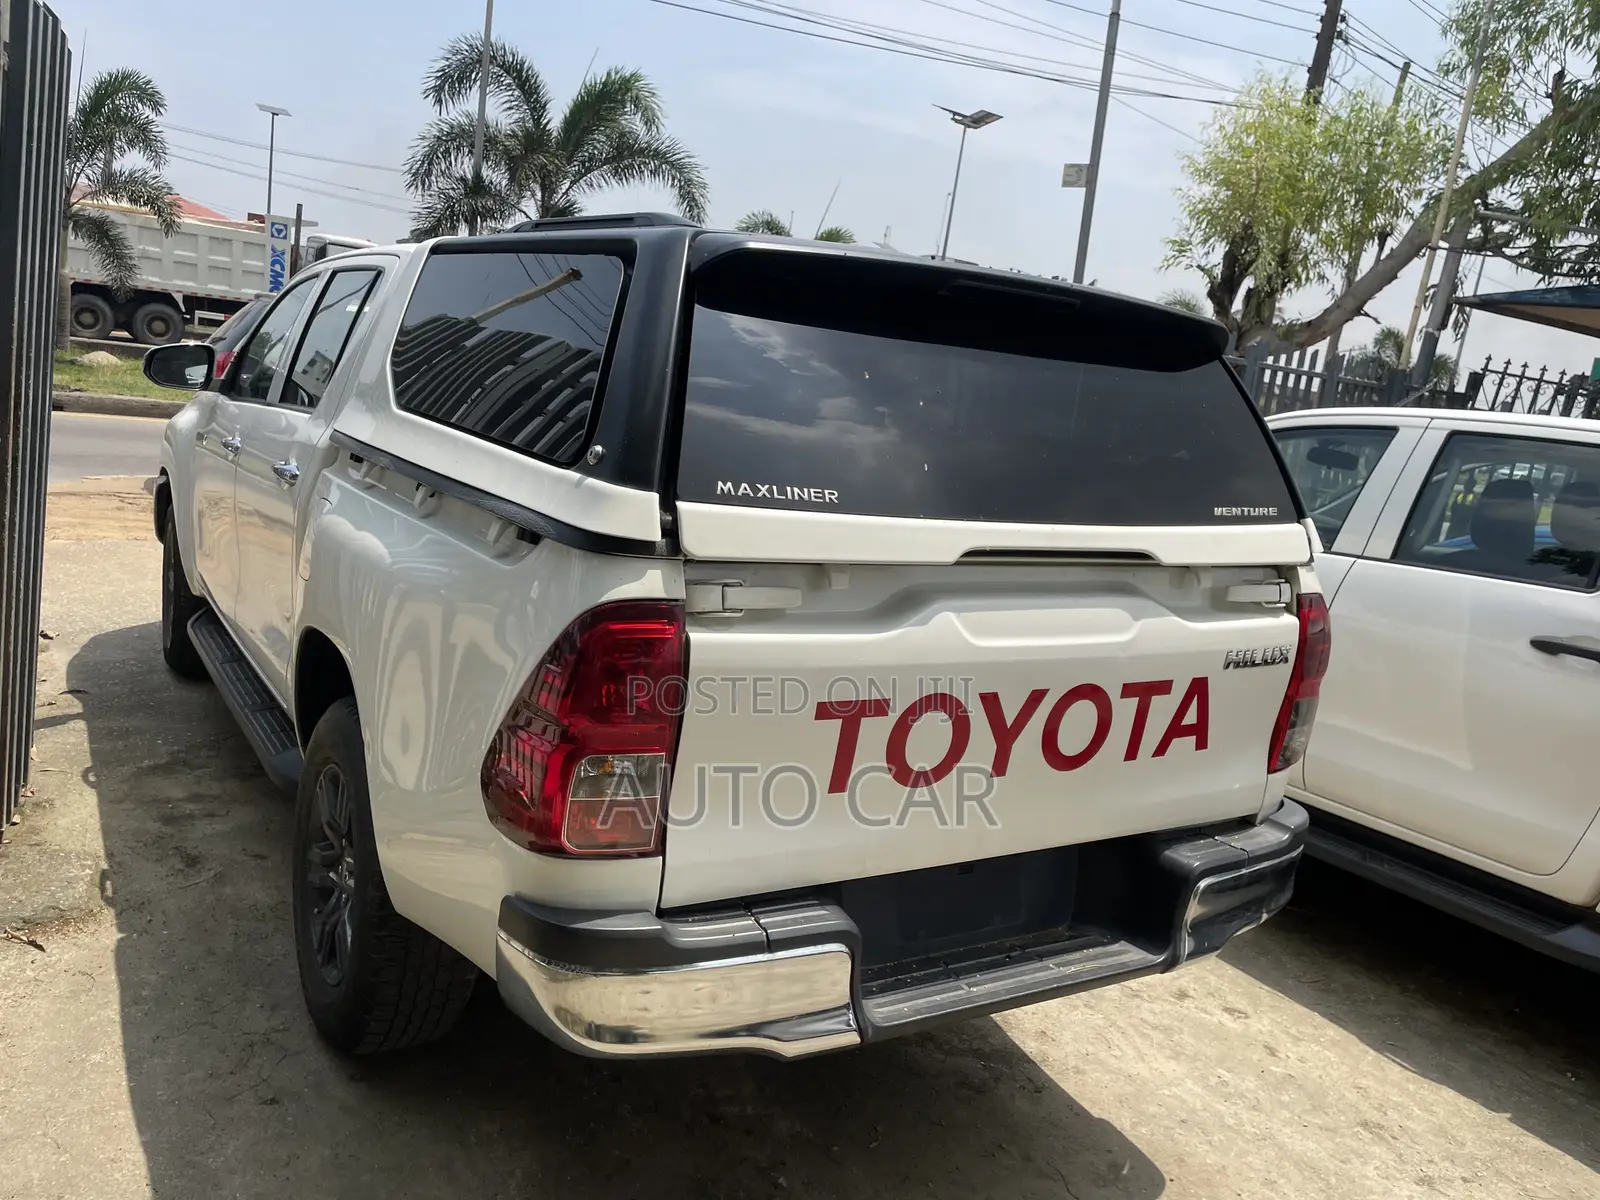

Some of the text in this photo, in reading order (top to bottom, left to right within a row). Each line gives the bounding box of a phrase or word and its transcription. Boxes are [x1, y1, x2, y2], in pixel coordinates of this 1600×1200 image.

[716, 480, 839, 503] MAXLINER
[1214, 507, 1278, 516] VENTURE
[1223, 645, 1292, 670] HILUX
[814, 676, 1209, 794] TOYOTA
